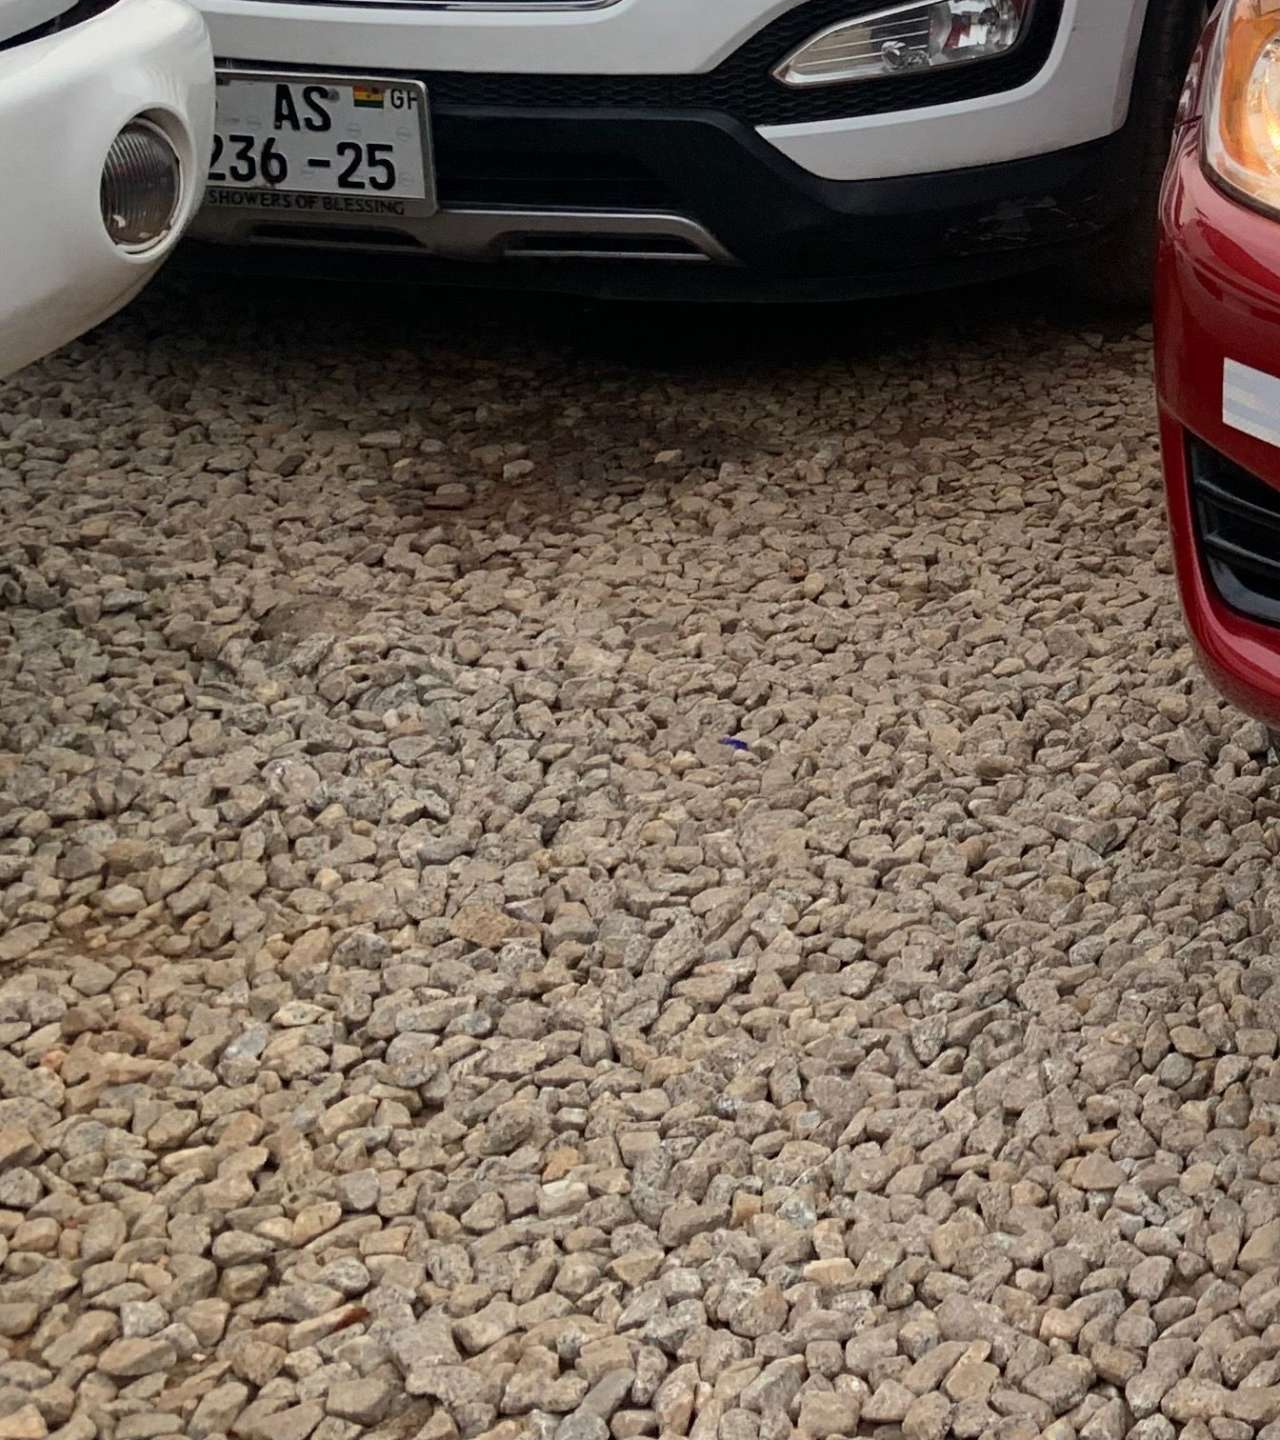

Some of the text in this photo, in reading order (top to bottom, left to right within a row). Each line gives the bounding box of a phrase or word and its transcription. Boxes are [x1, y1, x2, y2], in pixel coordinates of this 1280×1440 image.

[274, 83, 332, 132] AS
[208, 190, 405, 215] SHOWERS OF BLESSING
